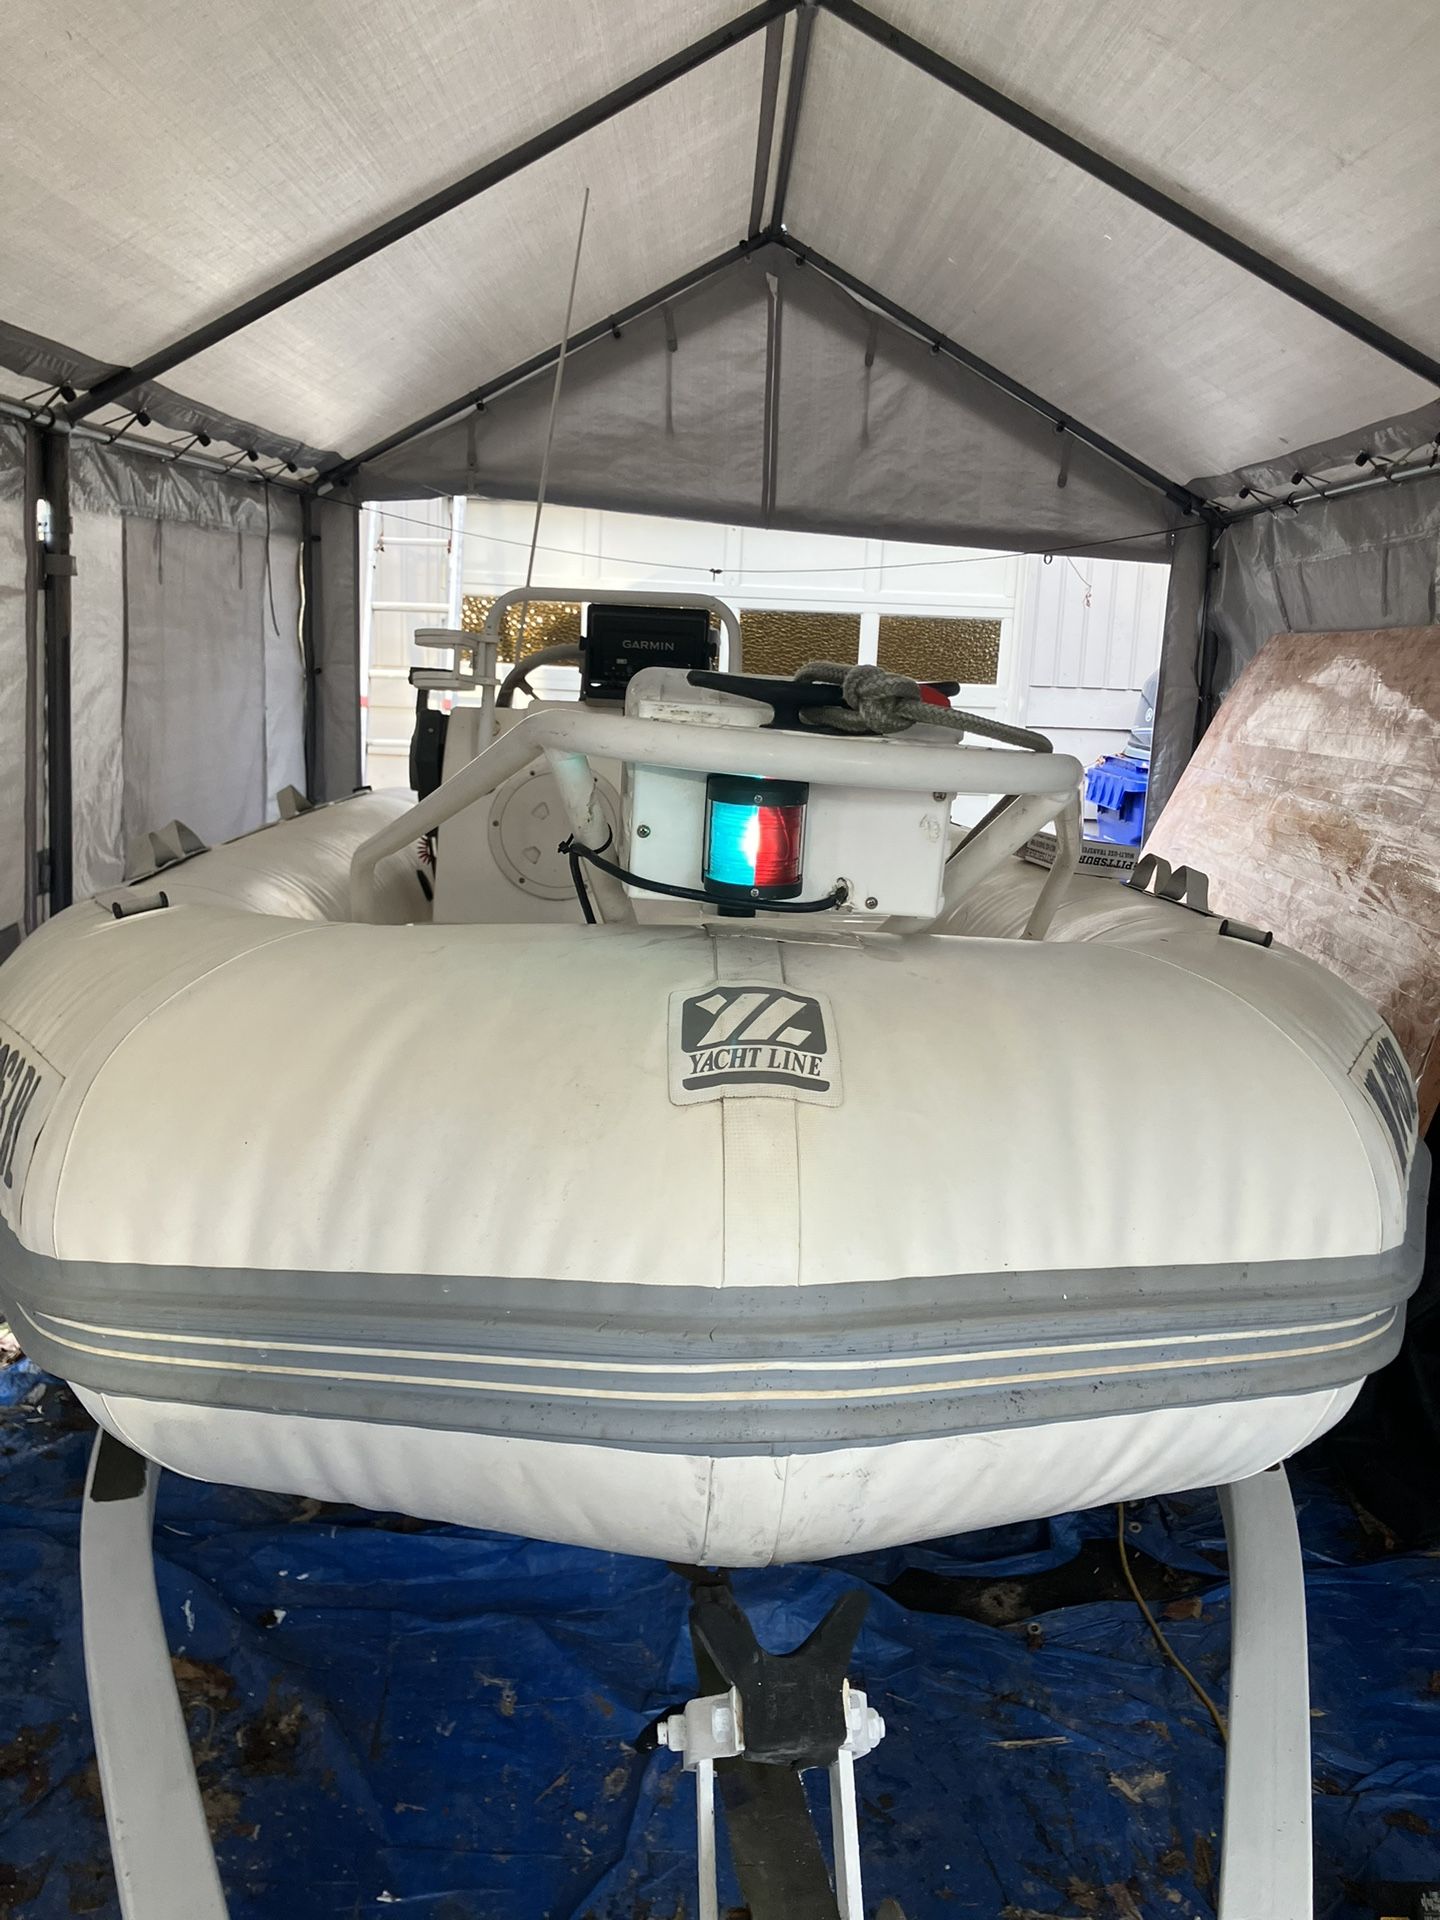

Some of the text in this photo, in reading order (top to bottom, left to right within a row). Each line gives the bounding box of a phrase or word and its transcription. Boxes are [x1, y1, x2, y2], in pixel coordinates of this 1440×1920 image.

[622, 640, 675, 651] GARMIN
[689, 1047, 823, 1077] YACHT LINE
